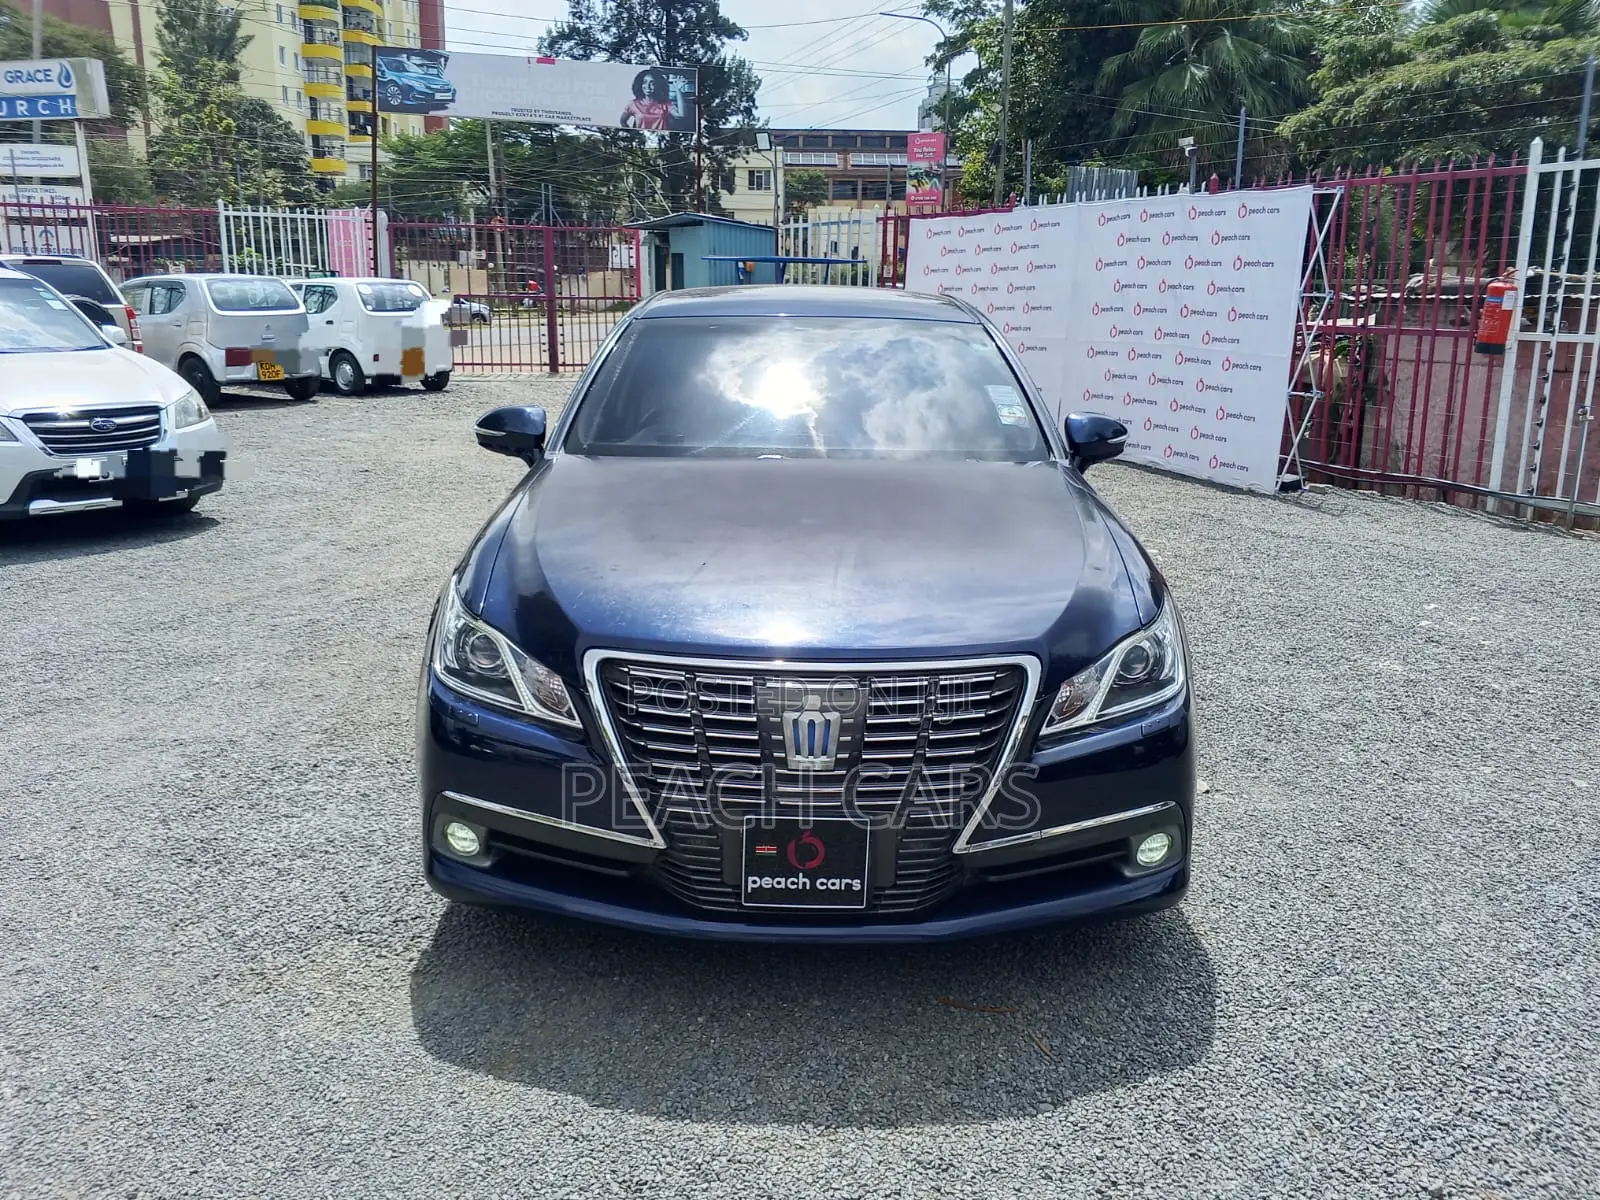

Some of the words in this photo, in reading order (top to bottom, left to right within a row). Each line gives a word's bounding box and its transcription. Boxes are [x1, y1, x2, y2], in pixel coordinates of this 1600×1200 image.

[4, 69, 54, 84] GRACE
[1149, 211, 1164, 220] peach
[1198, 209, 1214, 218] peach
[1248, 206, 1266, 216] peach
[1126, 236, 1140, 244] peach
[1171, 234, 1187, 243] peach
[1221, 234, 1237, 243] peach
[1146, 259, 1160, 267] peach
[1194, 259, 1210, 268] peach
[1243, 260, 1261, 269] peach
[1121, 282, 1136, 292] peach
[1167, 283, 1182, 291] peach
[1216, 286, 1231, 294] peach
[1190, 308, 1206, 316] peach
[1163, 331, 1178, 339] peach
[748, 872, 810, 893] peach
[816, 878, 861, 891] cars
